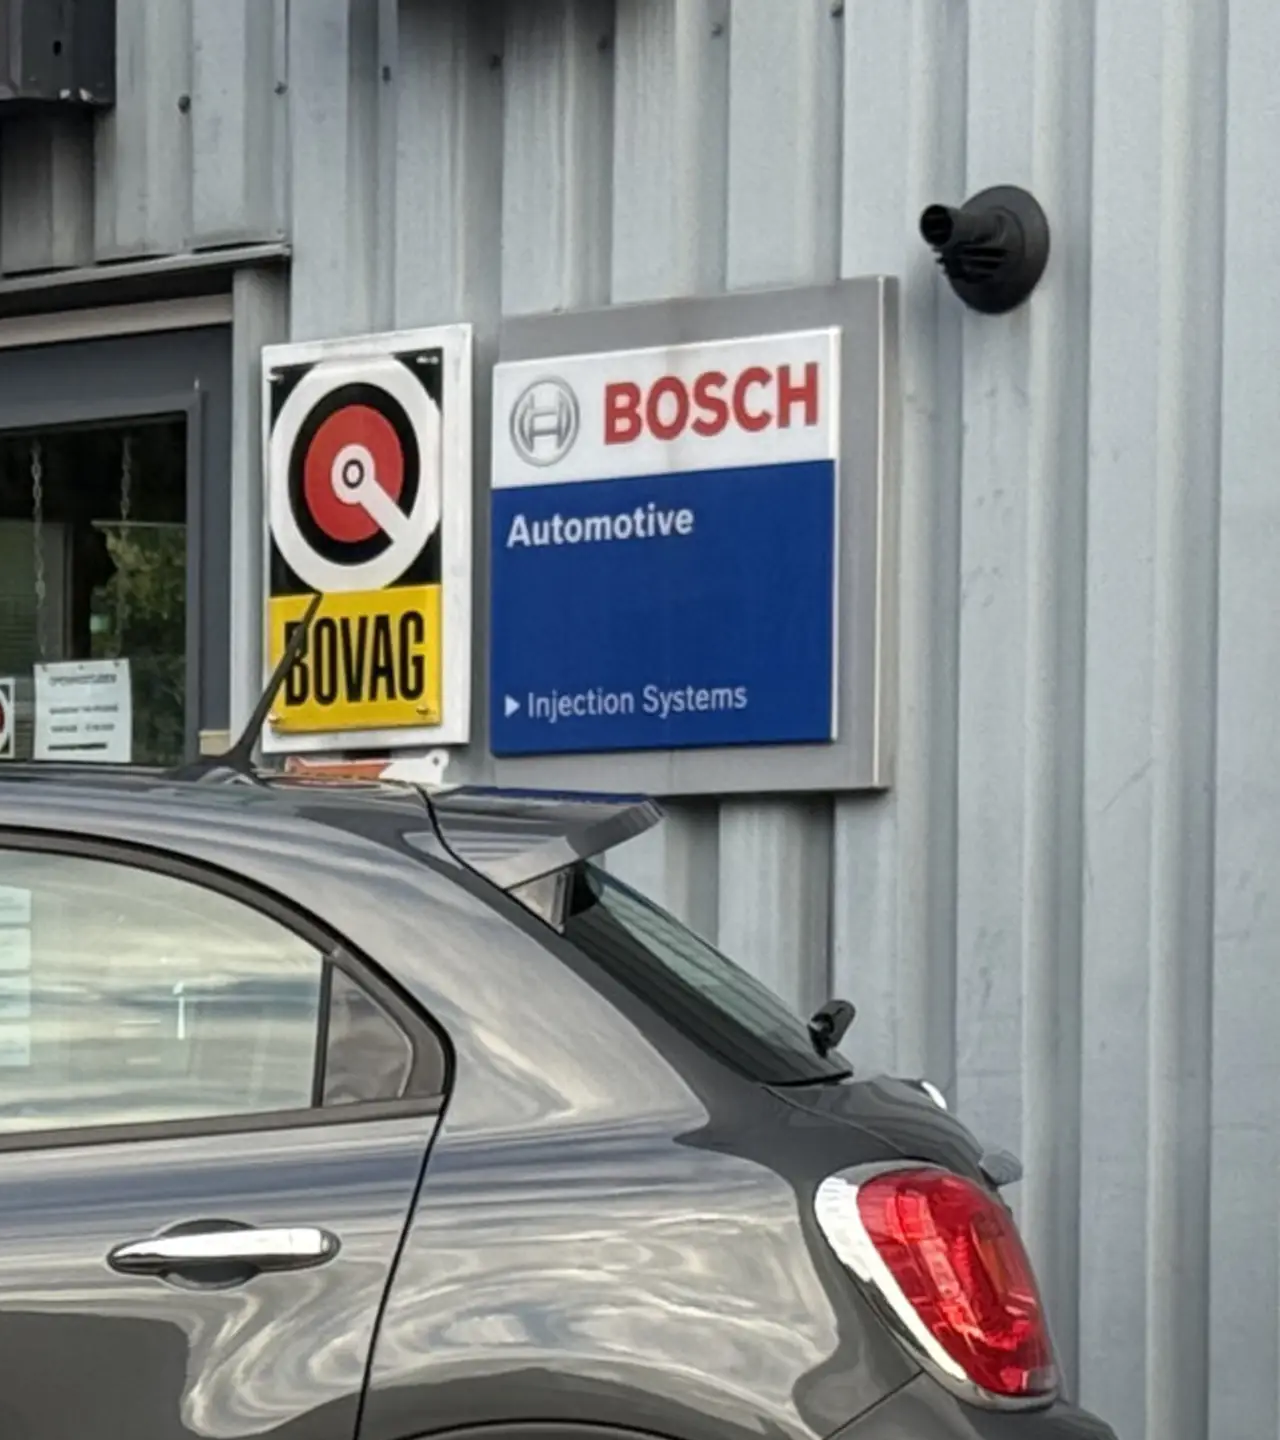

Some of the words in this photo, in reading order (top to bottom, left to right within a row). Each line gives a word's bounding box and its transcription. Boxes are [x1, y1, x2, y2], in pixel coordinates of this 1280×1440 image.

[603, 362, 820, 446] BOSCH
[506, 502, 695, 549] Automotive
[283, 610, 425, 707] BOVAG
[527, 687, 635, 724] Injection
[642, 684, 748, 720] Systems
